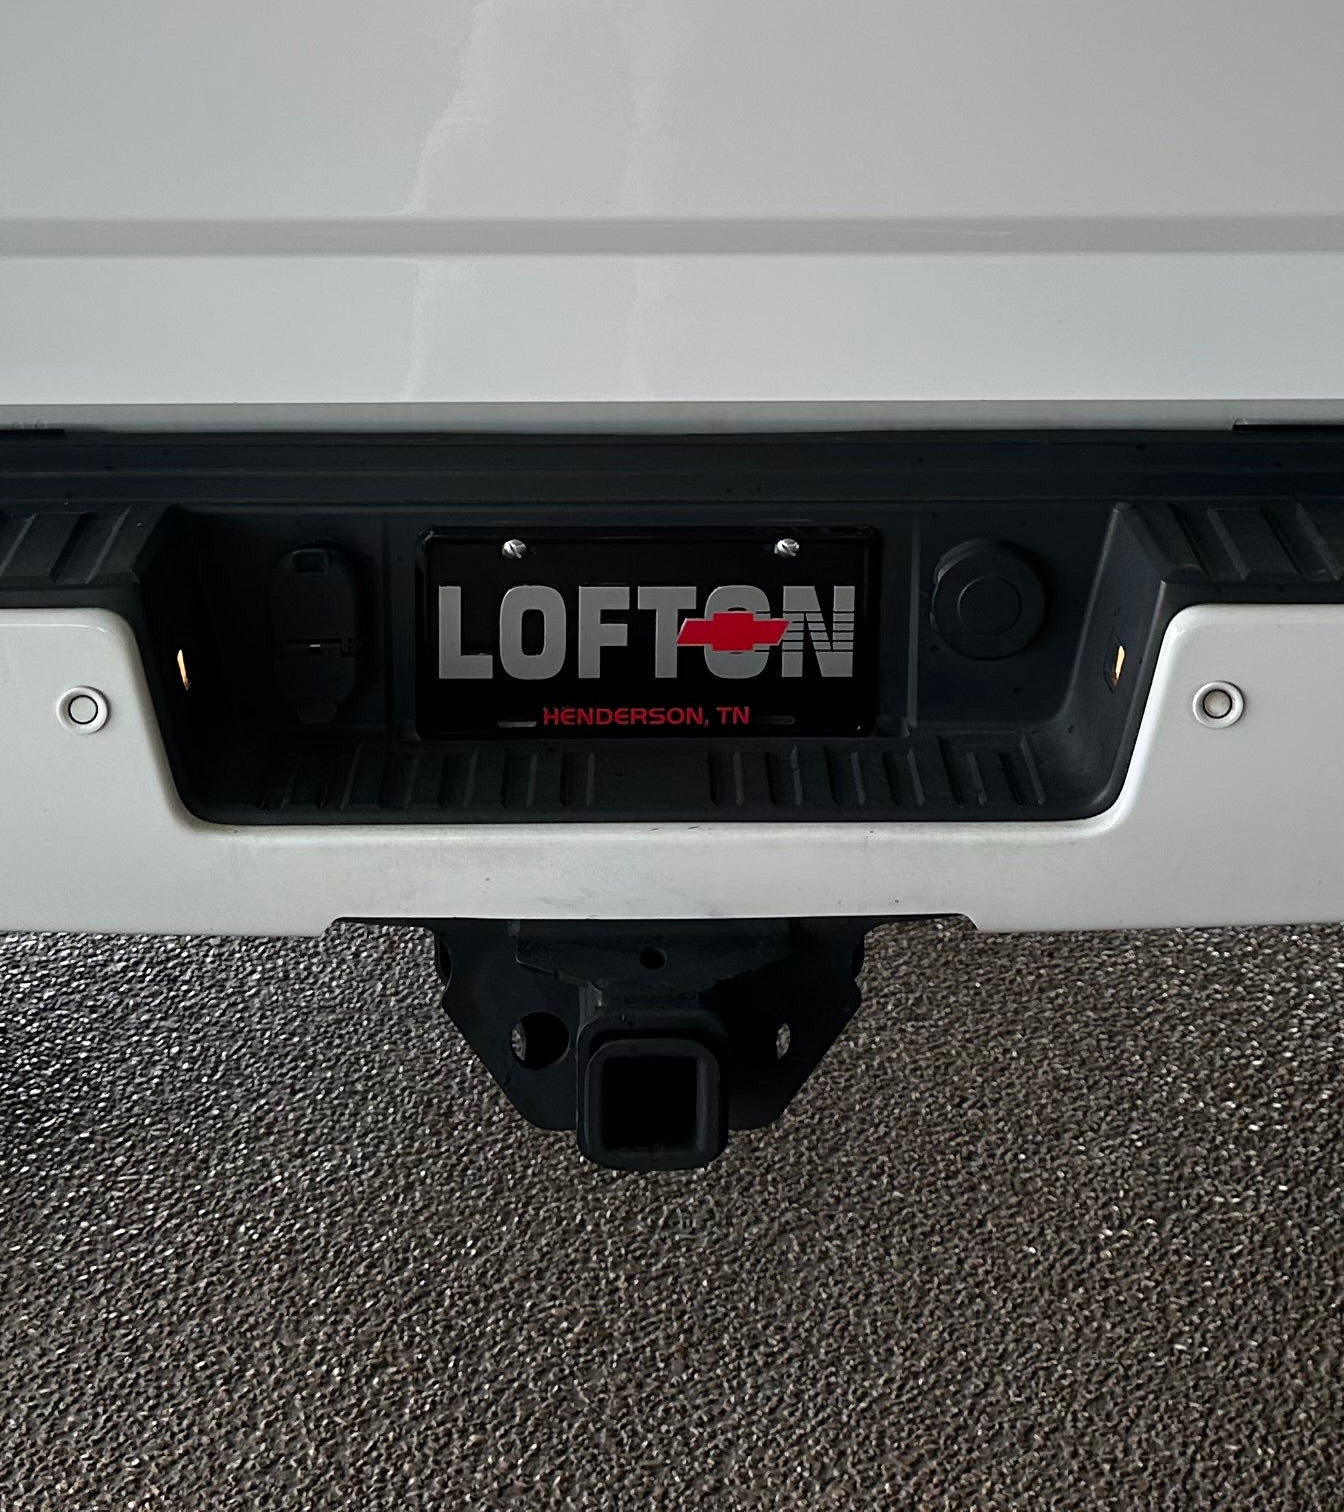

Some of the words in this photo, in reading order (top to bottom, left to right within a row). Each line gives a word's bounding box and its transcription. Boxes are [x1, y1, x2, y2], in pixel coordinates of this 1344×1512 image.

[438, 585, 856, 679] LOFTON
[542, 706, 709, 728] HENDERSON,
[716, 706, 750, 726] TN
